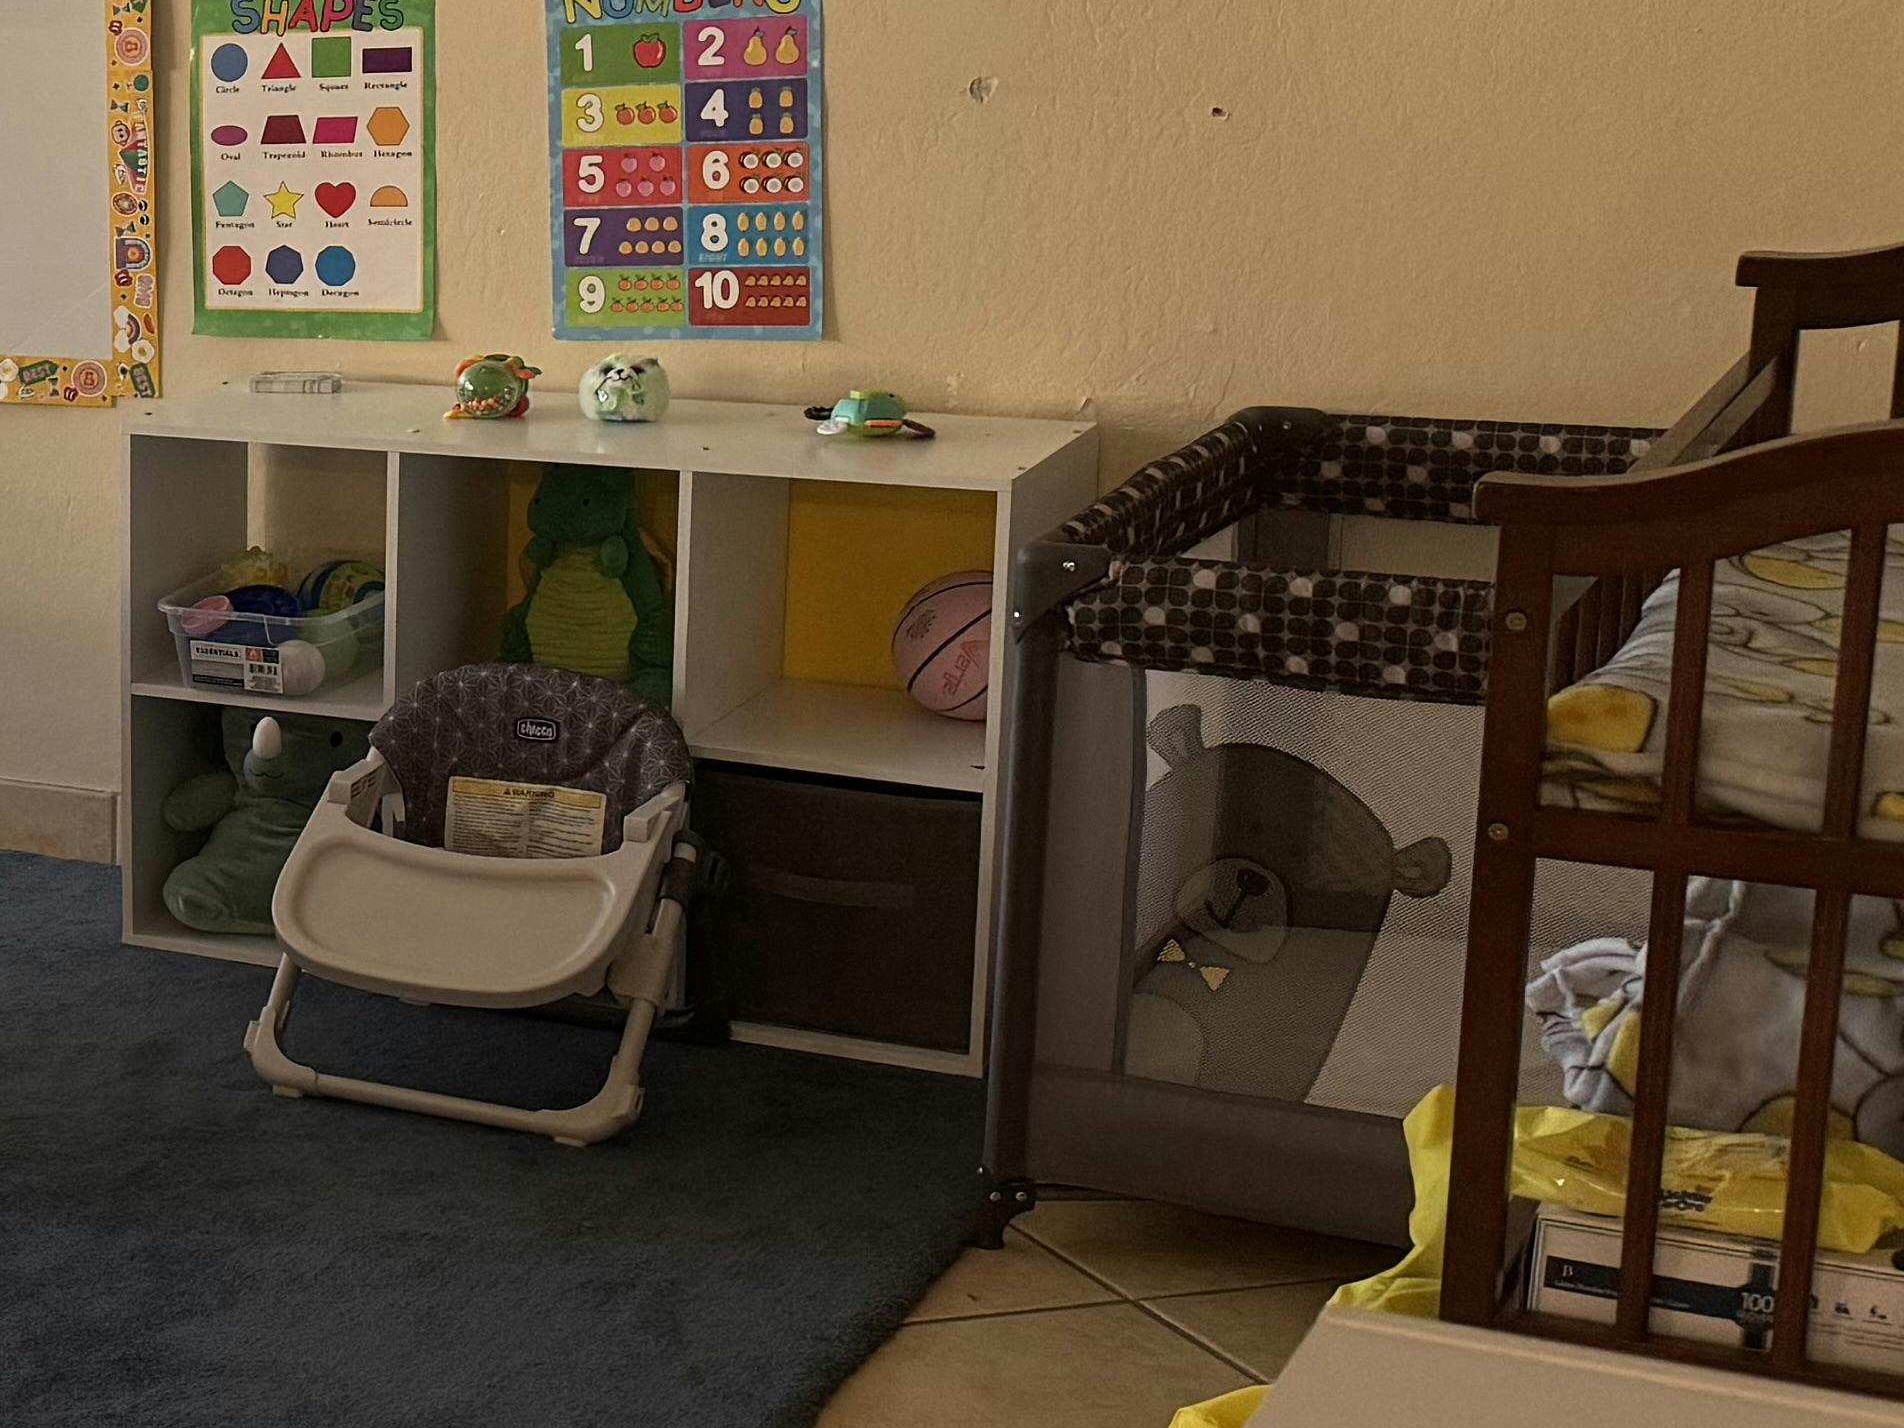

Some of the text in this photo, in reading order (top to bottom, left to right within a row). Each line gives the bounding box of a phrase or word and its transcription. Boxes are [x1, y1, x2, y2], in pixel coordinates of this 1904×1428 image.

[575, 33, 593, 72] 1
[697, 26, 726, 67] 2
[215, 85, 240, 94] Circle
[261, 84, 296, 92] Triangle
[363, 81, 408, 91] Rectangle
[576, 93, 604, 133] 3
[700, 88, 729, 128] 4
[220, 152, 241, 161] Oval
[577, 154, 605, 193] 5
[701, 149, 730, 191] 6
[573, 217, 601, 255] 7
[700, 213, 728, 252] 8
[577, 274, 605, 314] 9
[694, 269, 740, 310] 10
[1741, 1291, 1775, 1314] 100
